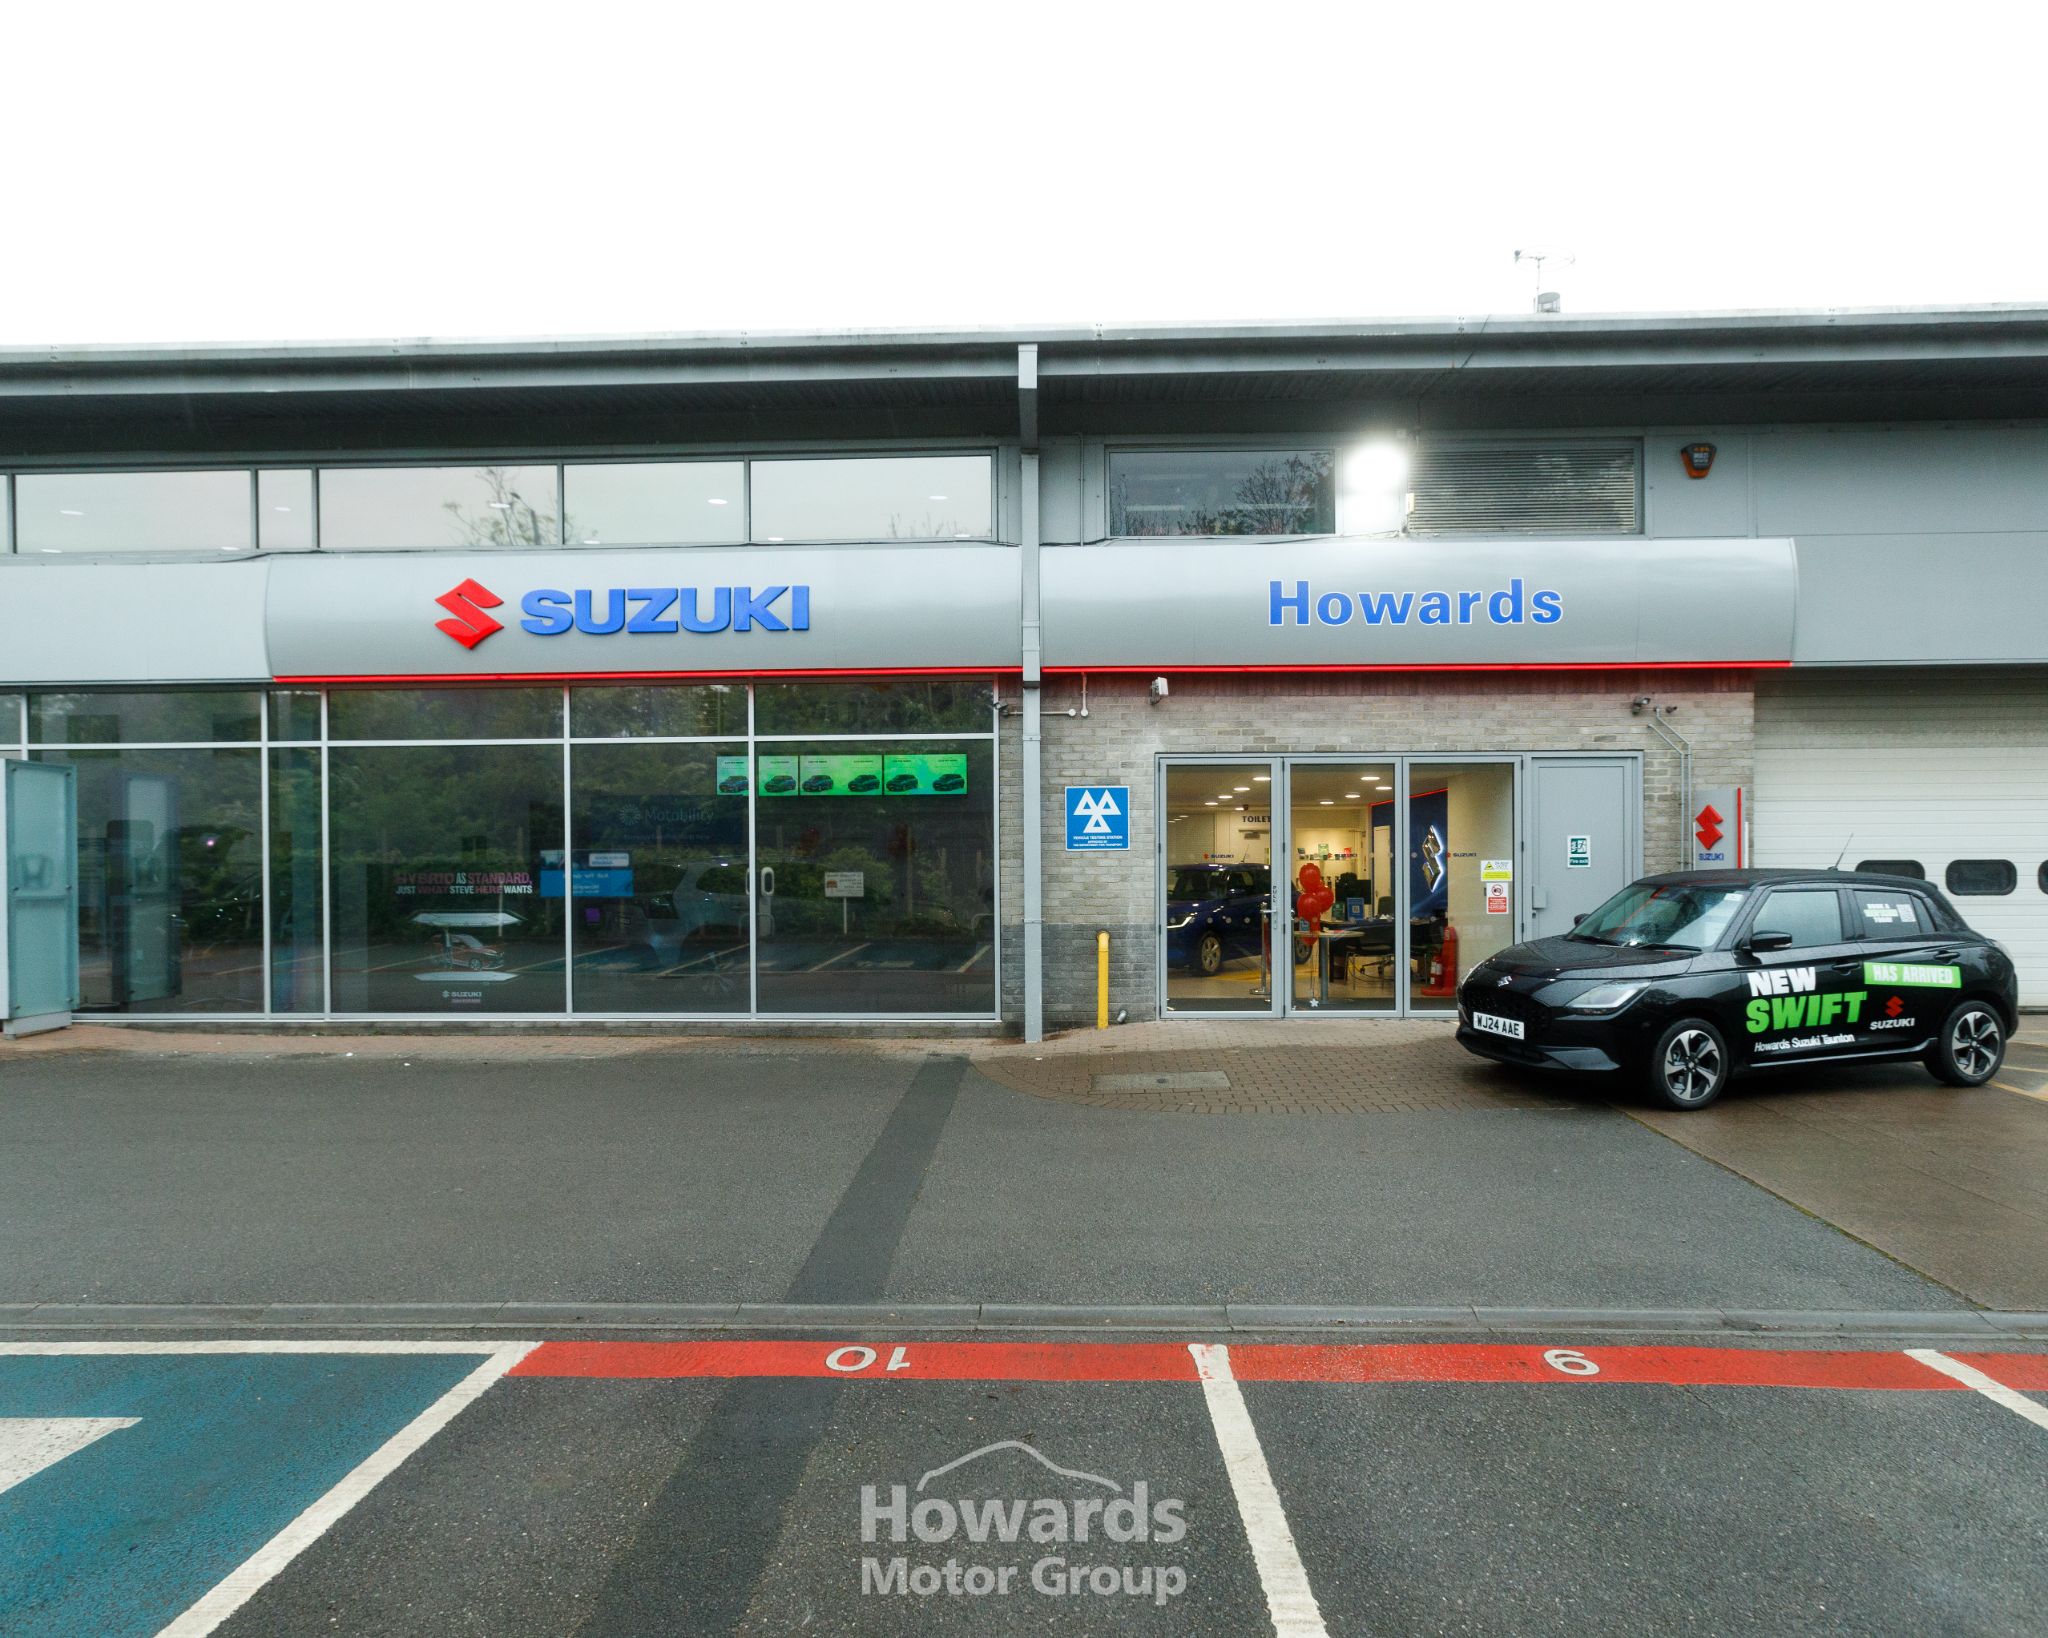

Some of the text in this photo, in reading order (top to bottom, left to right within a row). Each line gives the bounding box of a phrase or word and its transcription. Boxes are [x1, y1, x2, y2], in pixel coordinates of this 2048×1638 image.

[519, 585, 810, 636] SUZUKI
[1268, 577, 1563, 626] Howards
[1698, 853, 1725, 861] SUZUKI
[394, 872, 454, 884] HYBRID
[456, 872, 467, 884] AS
[396, 885, 416, 894] JUST
[450, 885, 474, 894] STEVE
[475, 886, 502, 894] HERE
[504, 885, 533, 894] WANTS
[1747, 966, 1816, 997] NEW
[1872, 965, 1953, 984] HAS ARRIVED
[1746, 991, 1867, 1033] SWIFT
[1477, 1014, 1520, 1037] WJ24 AAE
[1870, 1018, 1916, 1030] SUZUKI
[1754, 1033, 1855, 1052] Howards Suzuki Taunton
